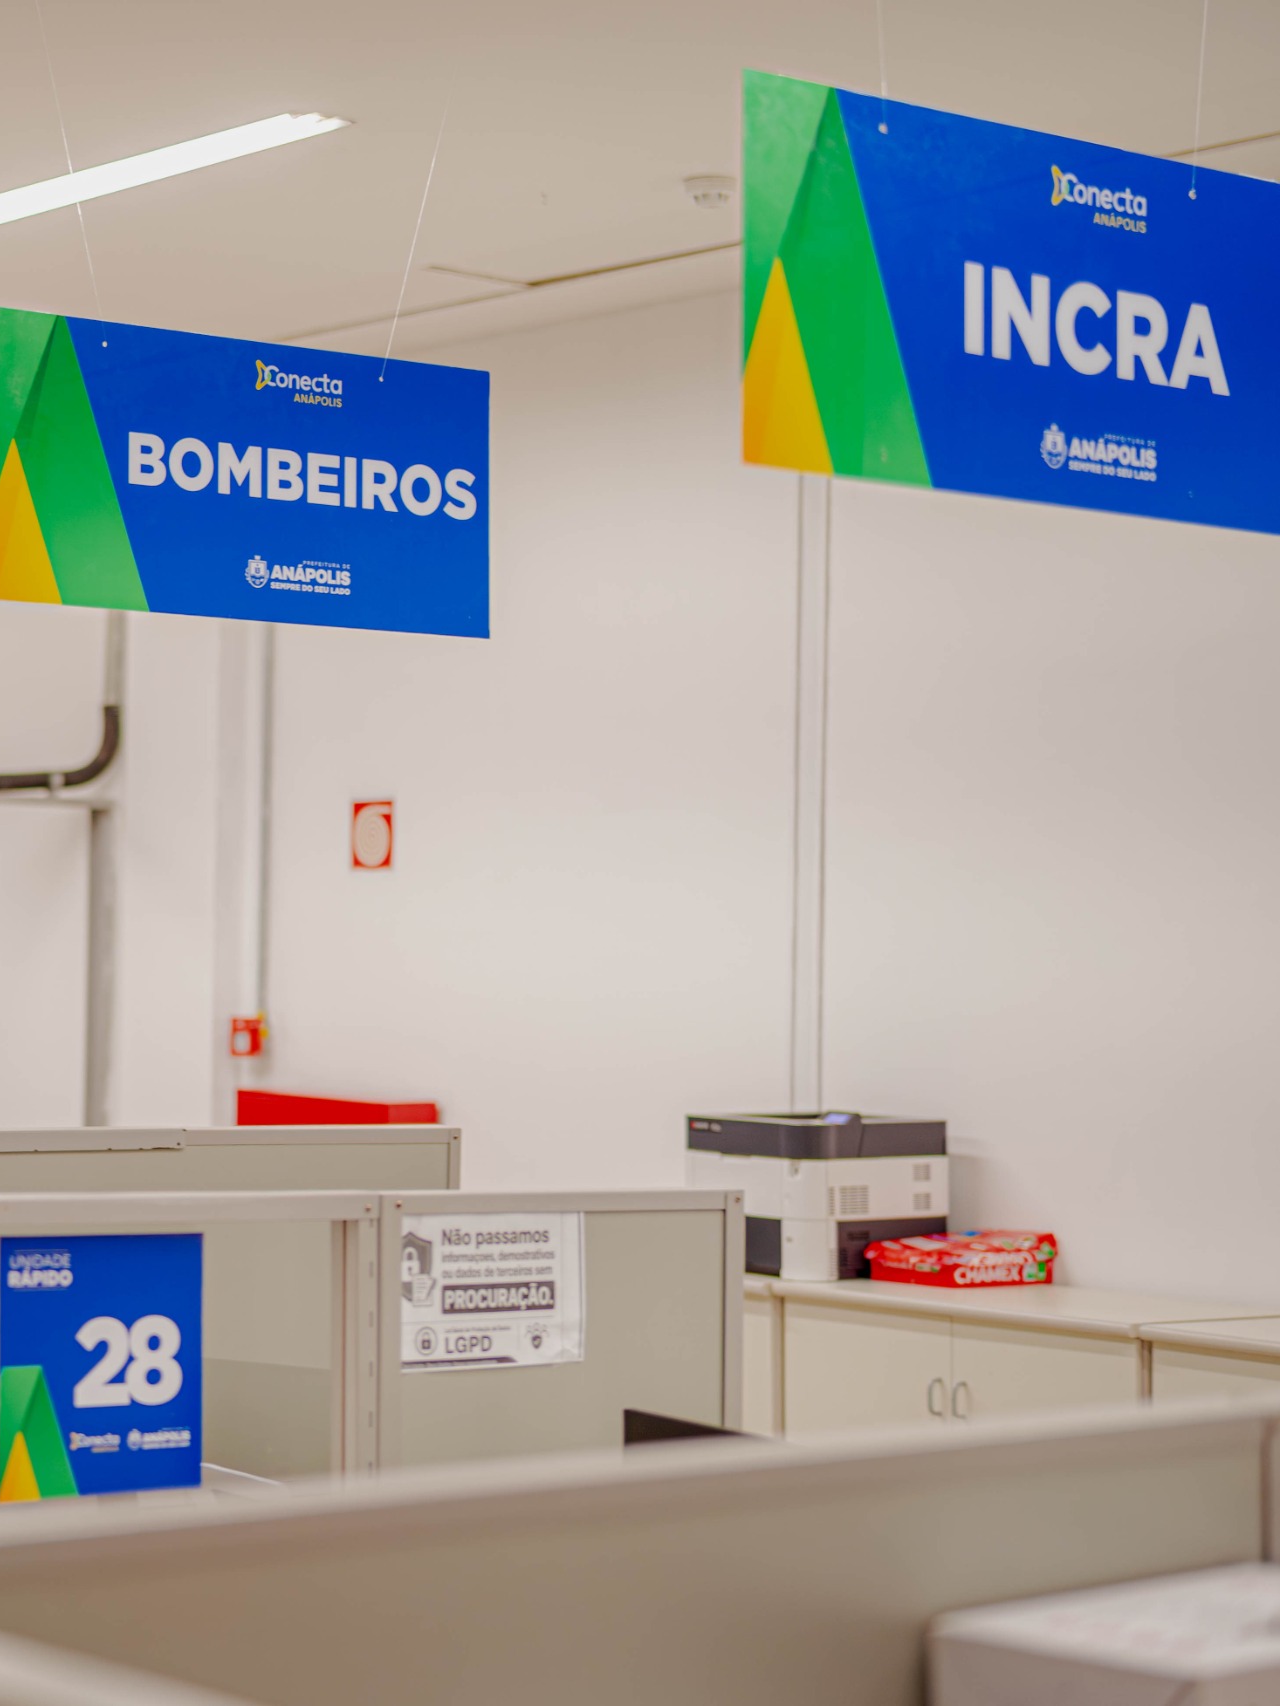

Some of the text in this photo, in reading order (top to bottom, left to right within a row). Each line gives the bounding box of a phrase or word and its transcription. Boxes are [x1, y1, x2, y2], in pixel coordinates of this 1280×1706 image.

[1060, 171, 1148, 218] Conecta
[1093, 212, 1147, 234] ANÁPOLIS
[962, 259, 1231, 397] INCRA
[263, 365, 343, 395] Conecta
[293, 393, 343, 408] ANÁPOLIS
[1068, 436, 1157, 470] ANÁPOLIS
[127, 431, 478, 522] BOMBEIROS
[270, 564, 351, 586] ANÁPOLIS
[270, 582, 351, 596] SEMPRE DO SEU LADO
[442, 1228, 550, 1249] Não passamos
[8, 1254, 72, 1268] UNIDADE
[7, 1268, 73, 1288] RÁPIDO
[954, 1265, 1021, 1285] CHAMEX
[444, 1282, 555, 1311] PROCURAÇÃO.
[445, 1335, 493, 1354] LGPD
[72, 1314, 183, 1408] 28
